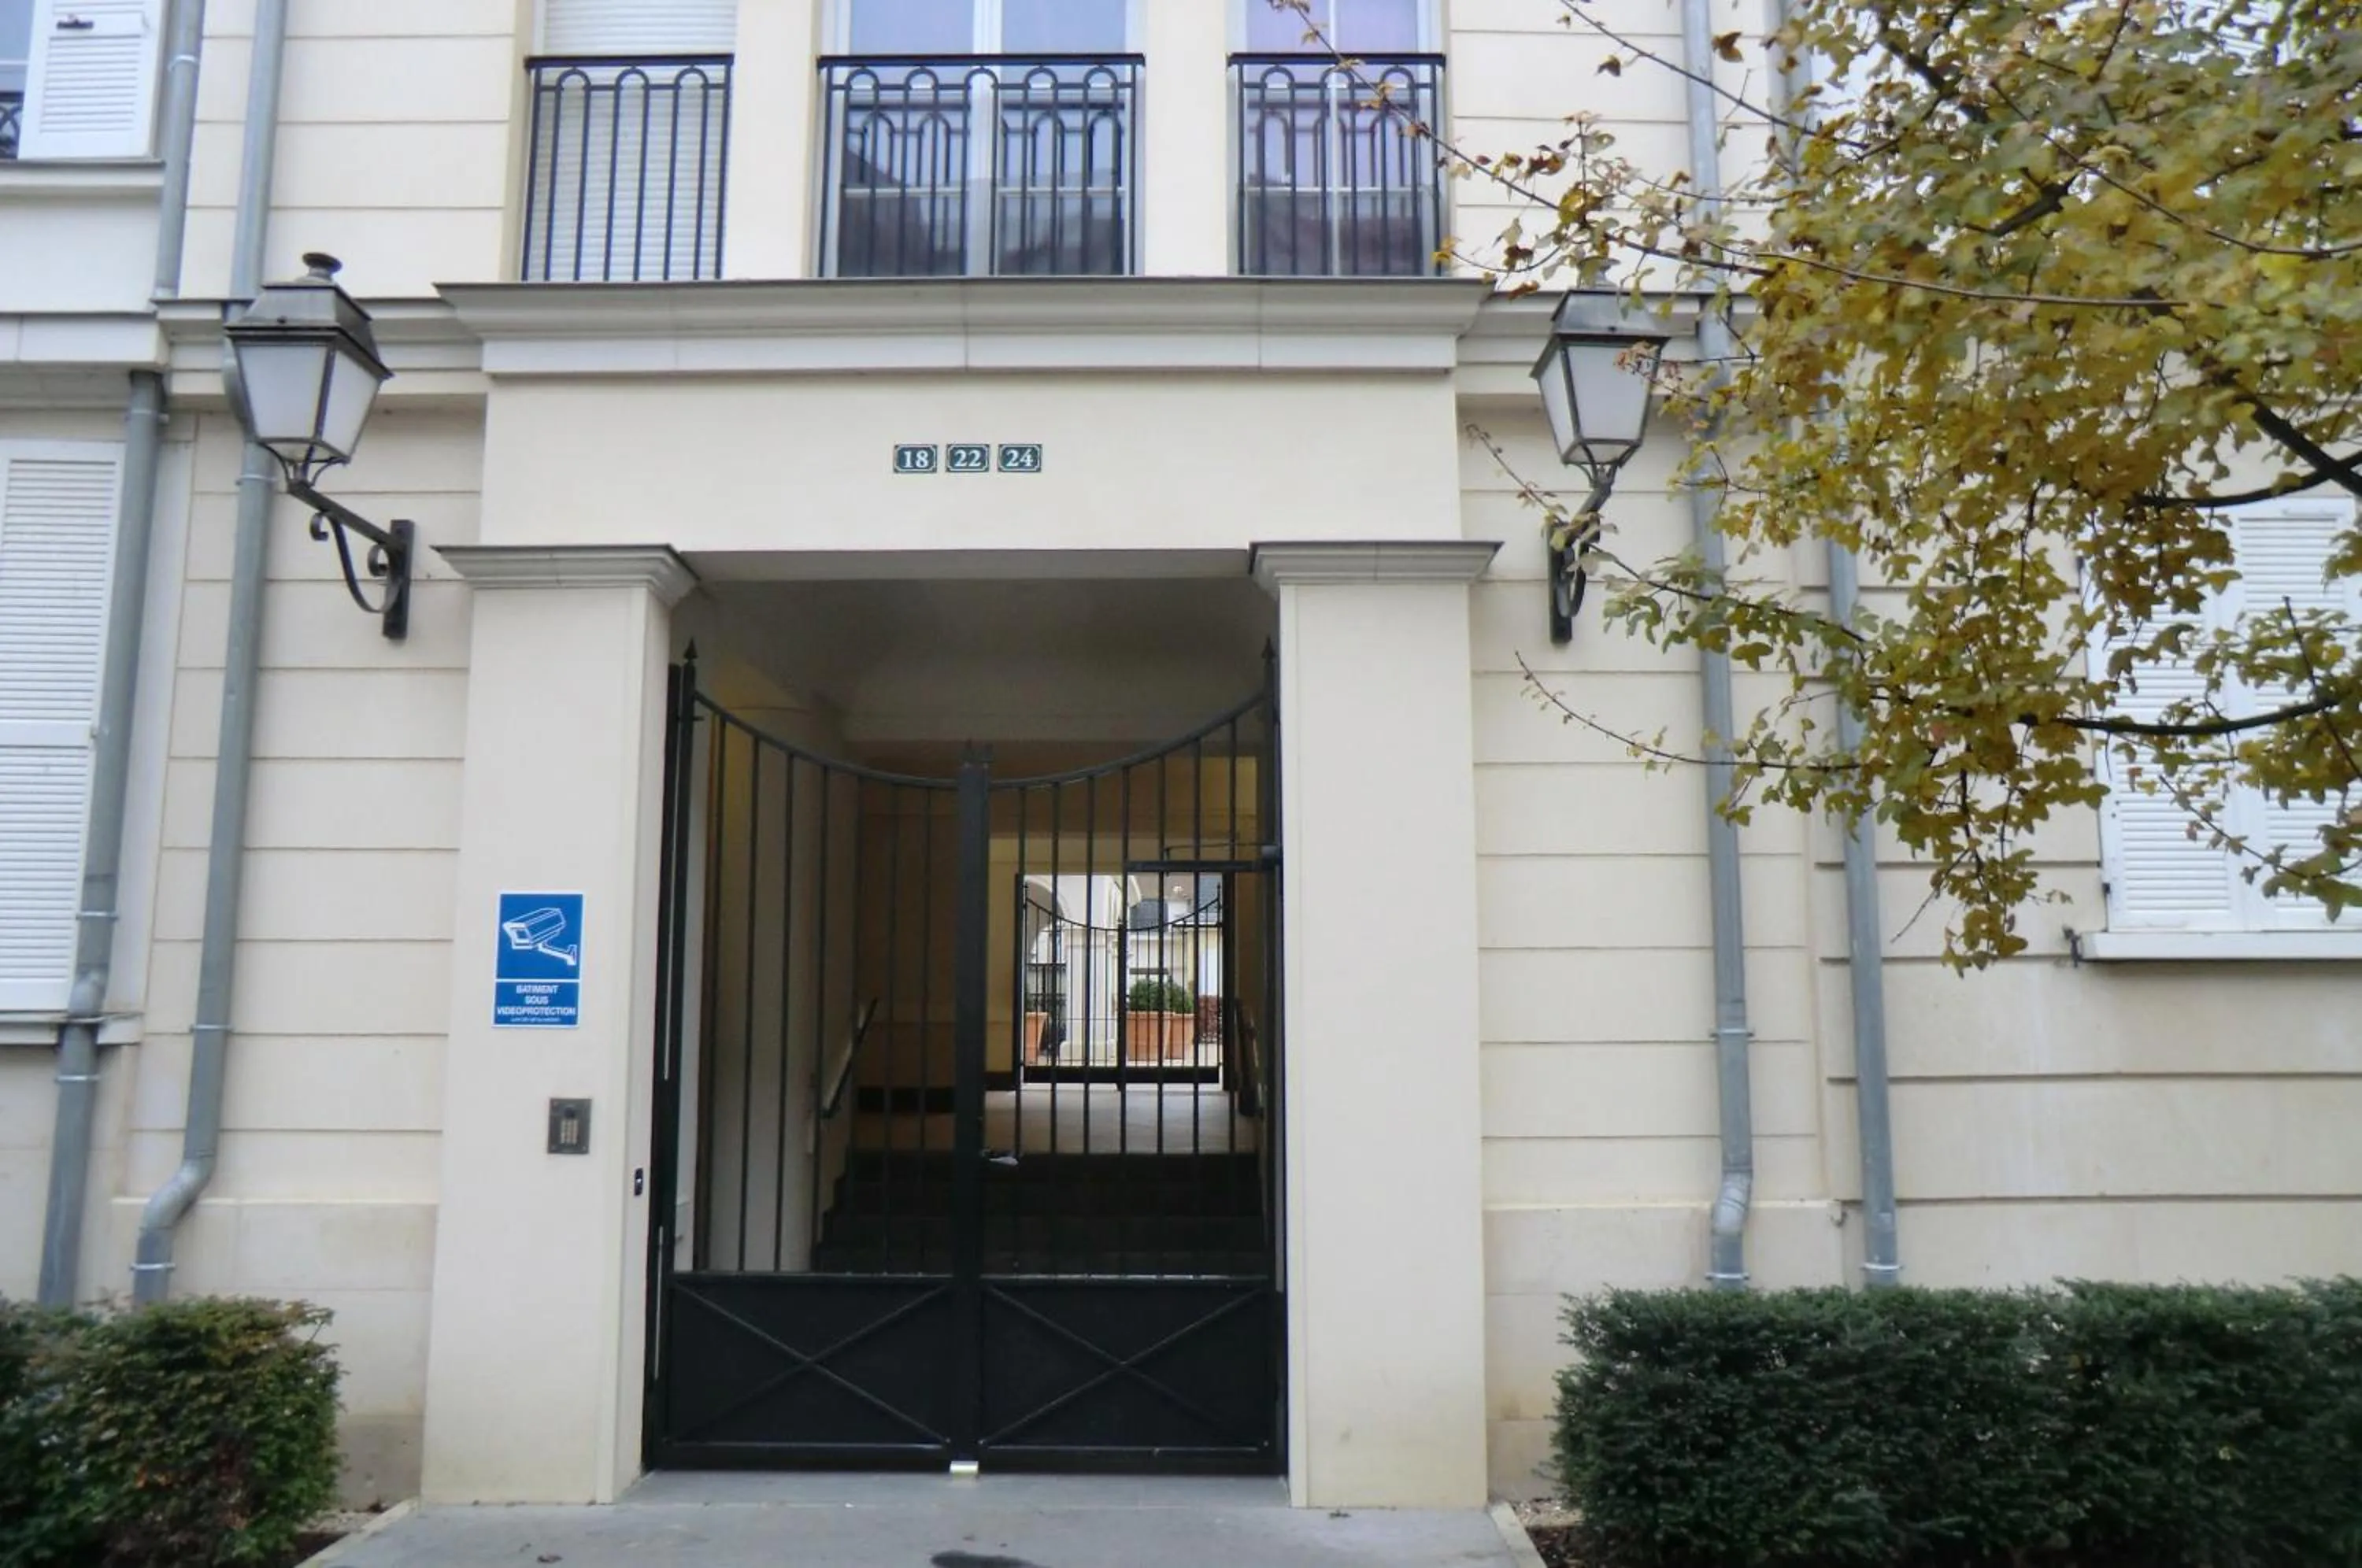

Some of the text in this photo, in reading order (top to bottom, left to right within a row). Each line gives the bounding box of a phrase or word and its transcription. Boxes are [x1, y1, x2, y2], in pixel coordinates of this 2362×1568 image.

[903, 450, 929, 468] 18
[953, 450, 981, 467] 22
[1005, 449, 1034, 467] 24
[524, 996, 549, 1004] SOUS
